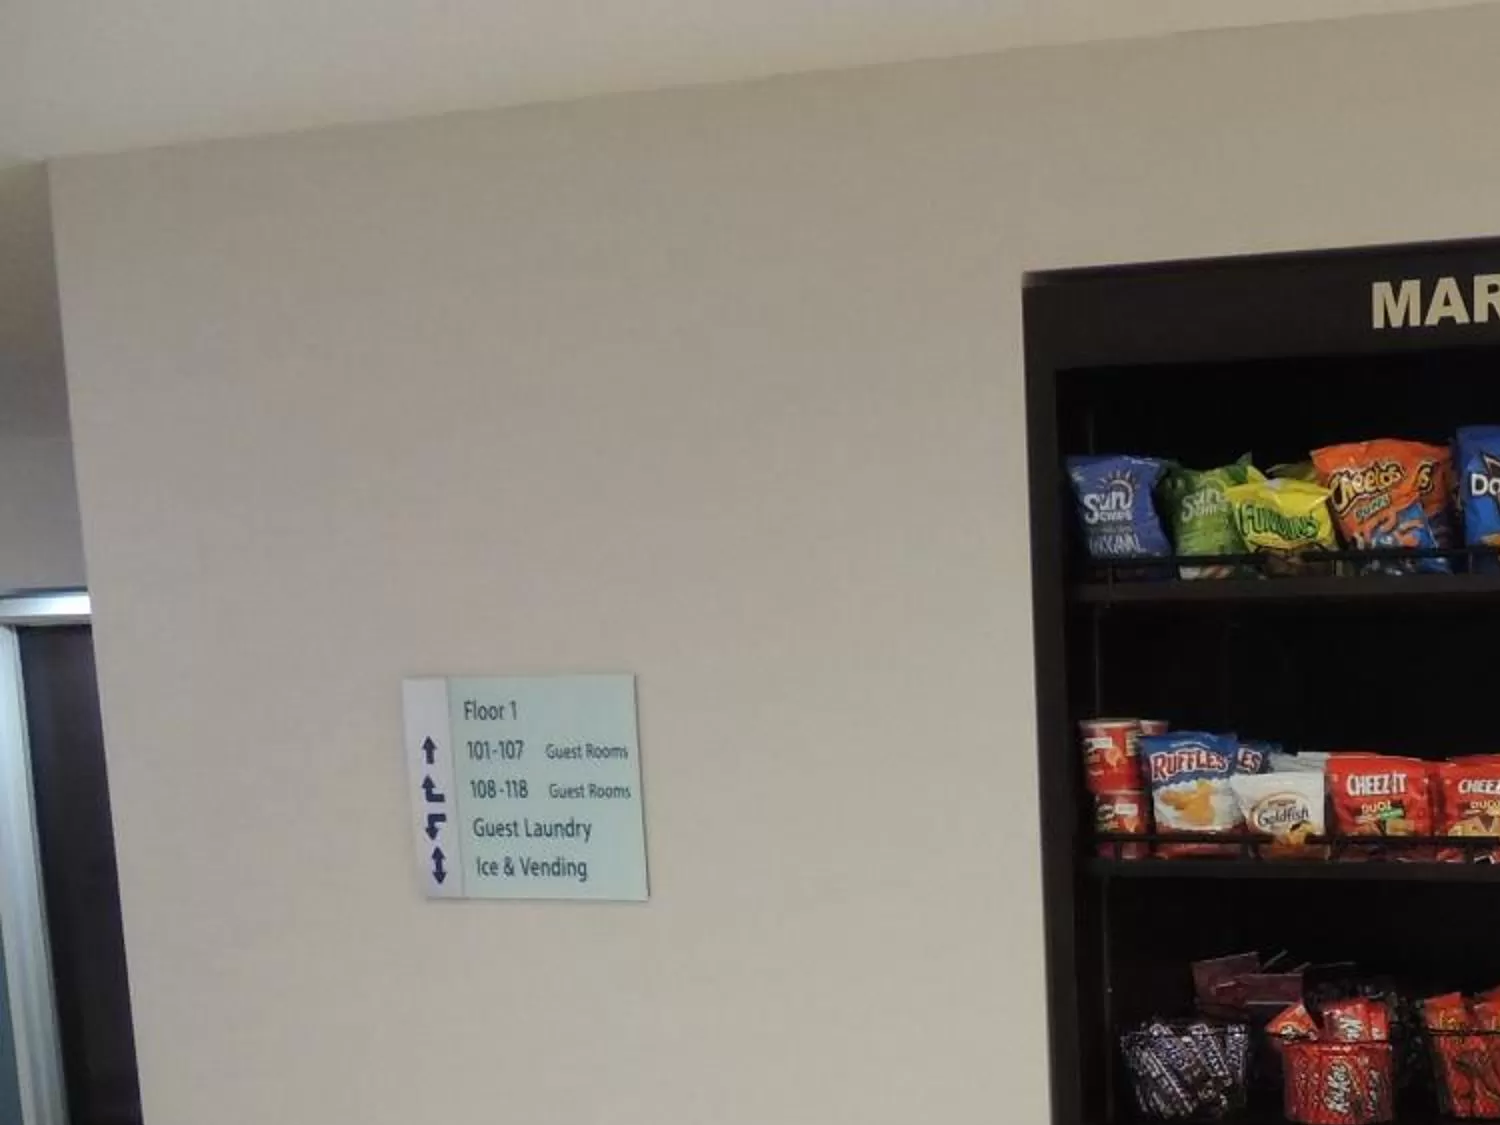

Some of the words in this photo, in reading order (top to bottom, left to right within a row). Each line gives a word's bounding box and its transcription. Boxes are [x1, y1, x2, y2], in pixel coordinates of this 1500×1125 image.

[1329, 461, 1402, 515] Cheetos
[1084, 491, 1134, 525] Sun
[463, 700, 503, 721] Floor
[510, 701, 518, 720] 1
[467, 740, 524, 760] 101-107
[545, 743, 582, 760] Guest
[586, 744, 628, 760] Rooms
[1151, 750, 1231, 781] RUFFLES
[470, 779, 529, 799] 108-118
[549, 783, 586, 799] Guest
[588, 784, 632, 799] Rooms
[1259, 803, 1311, 826] Goldfish
[473, 817, 519, 838] Guest
[524, 817, 592, 843] Laundry
[477, 856, 499, 877] Ice
[503, 856, 515, 876] &
[520, 856, 588, 883] Vending
